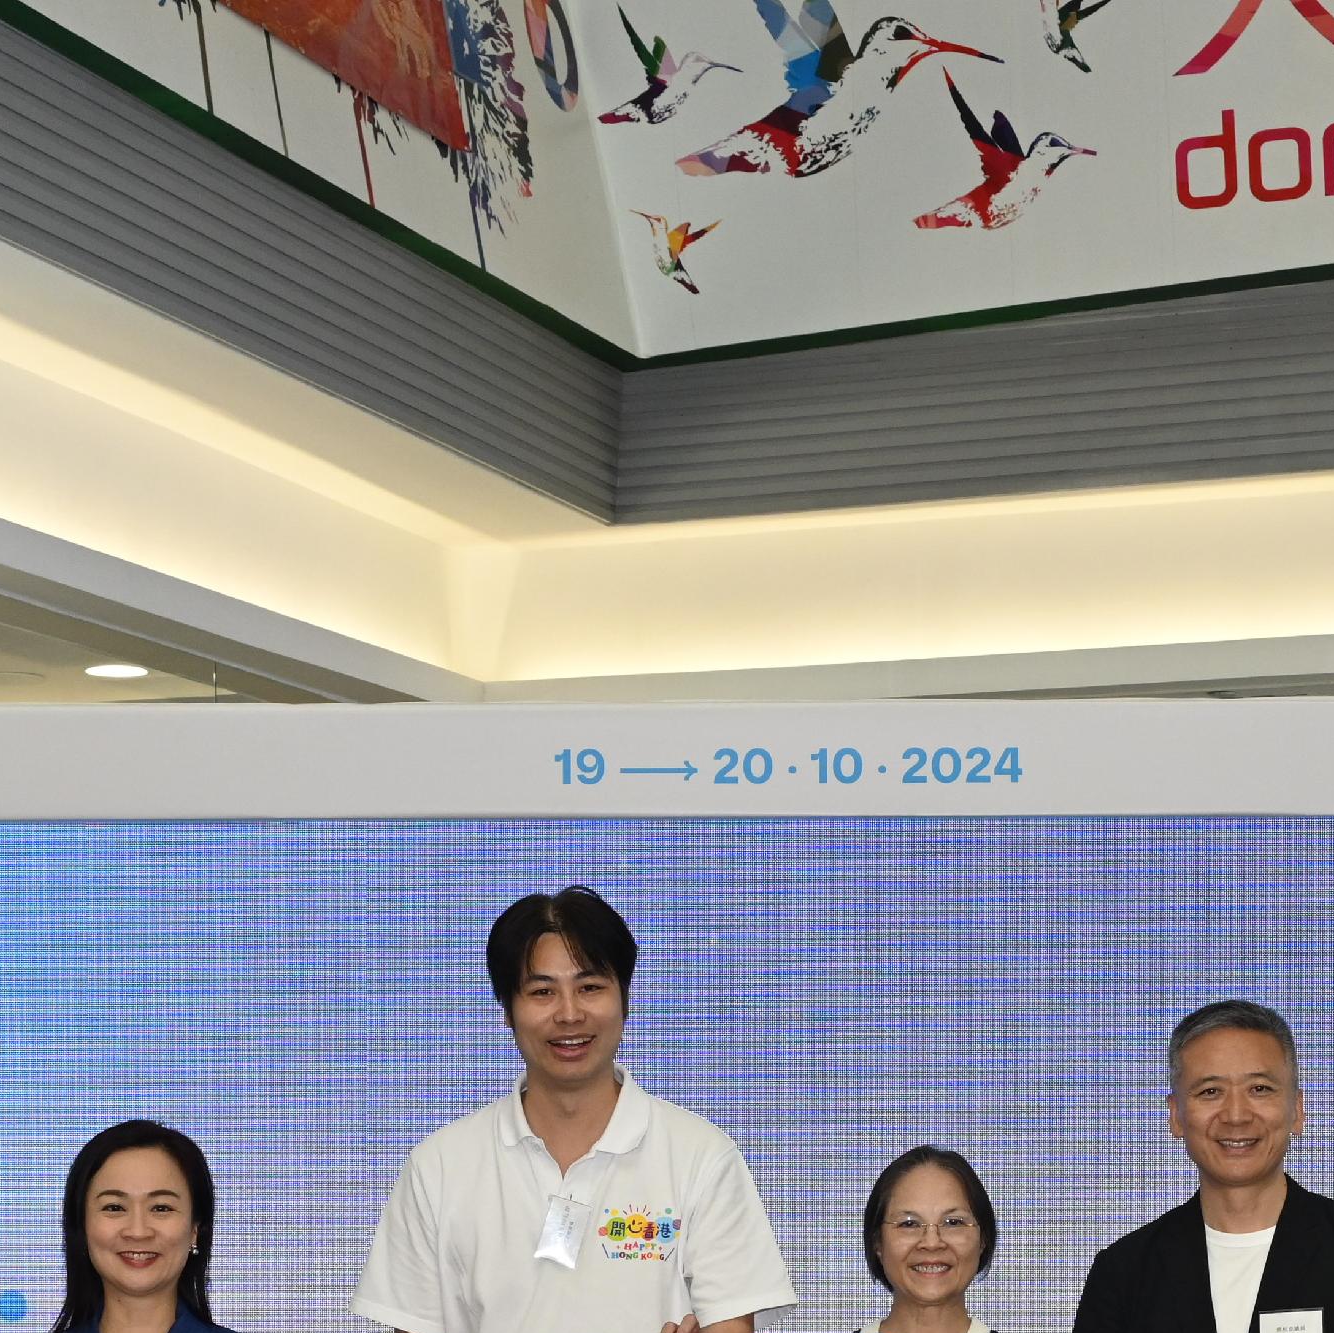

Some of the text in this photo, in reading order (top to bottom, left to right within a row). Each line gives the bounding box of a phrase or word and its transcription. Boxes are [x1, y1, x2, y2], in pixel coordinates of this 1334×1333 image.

[555, 748, 605, 785] 19
[623, 1240, 657, 1252] HAPPY
[611, 1250, 665, 1262] HONG KONG
